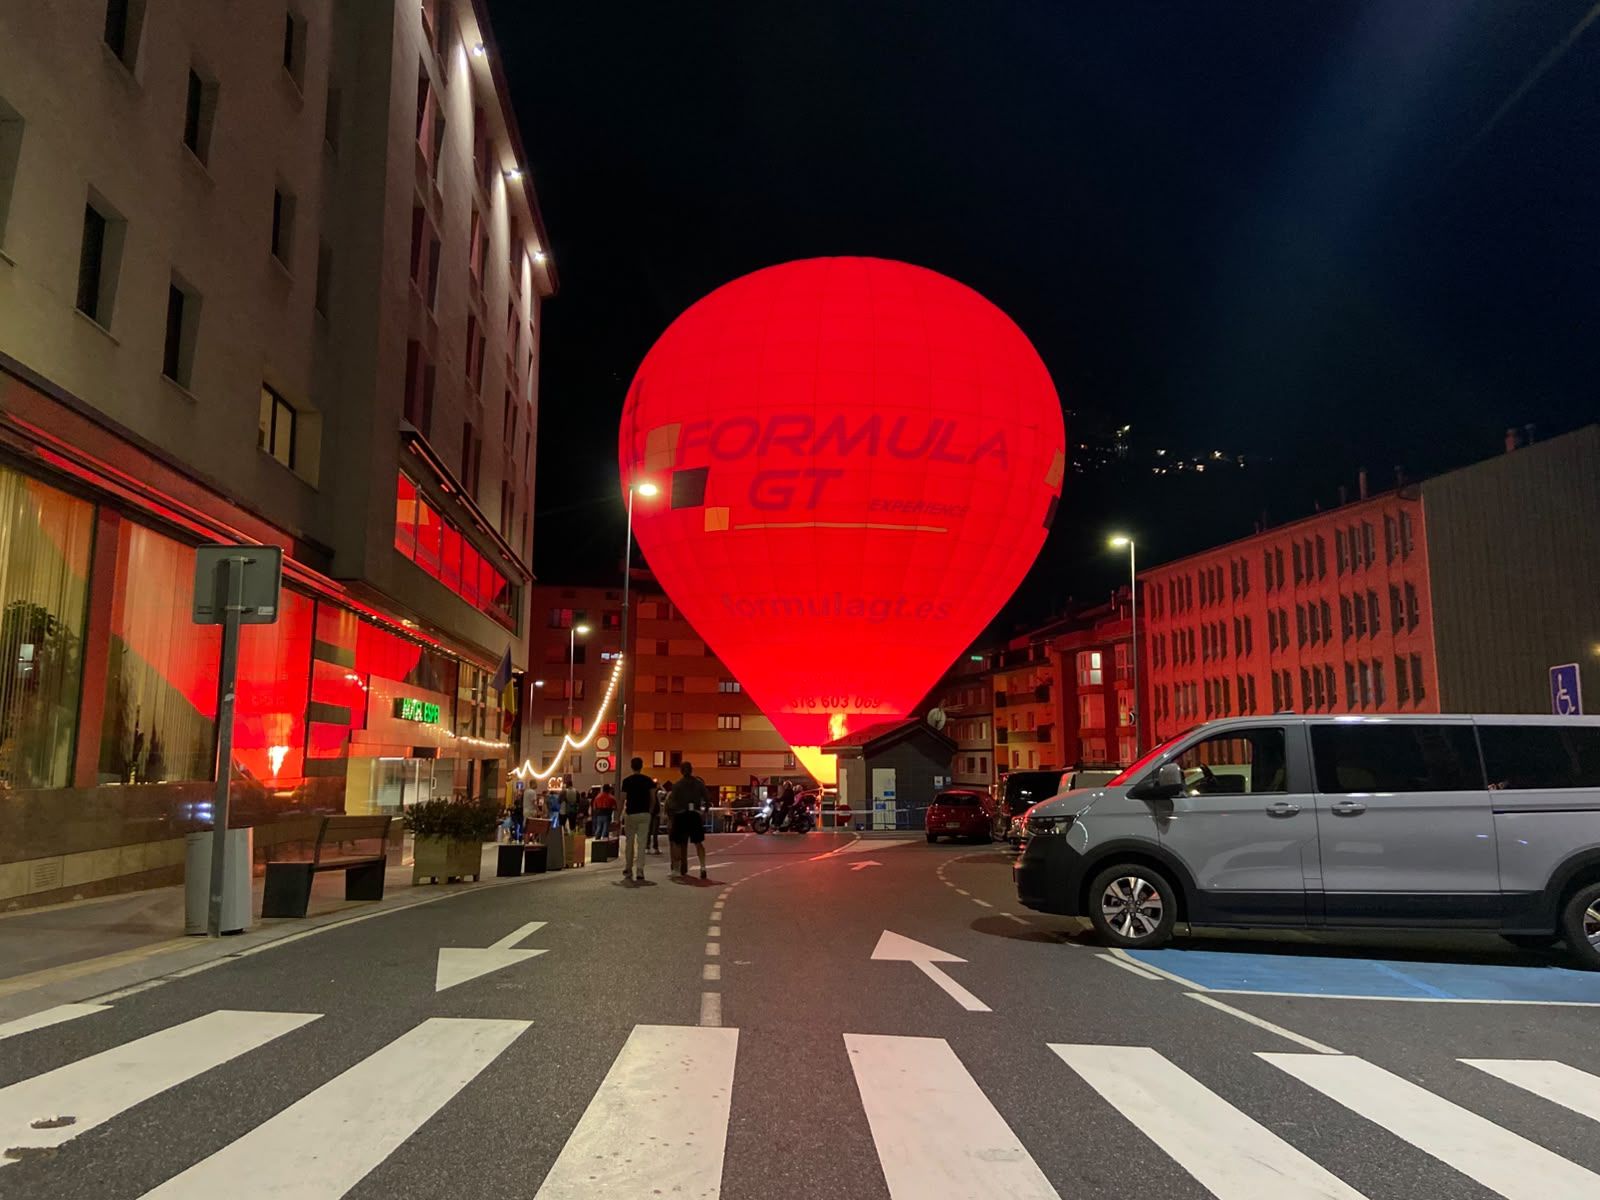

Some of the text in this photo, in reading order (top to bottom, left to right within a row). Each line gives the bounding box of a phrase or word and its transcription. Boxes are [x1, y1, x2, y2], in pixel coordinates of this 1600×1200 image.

[677, 414, 1009, 469] FORMULA
[748, 469, 844, 511] GT
[868, 497, 970, 518] EXPERIENCE
